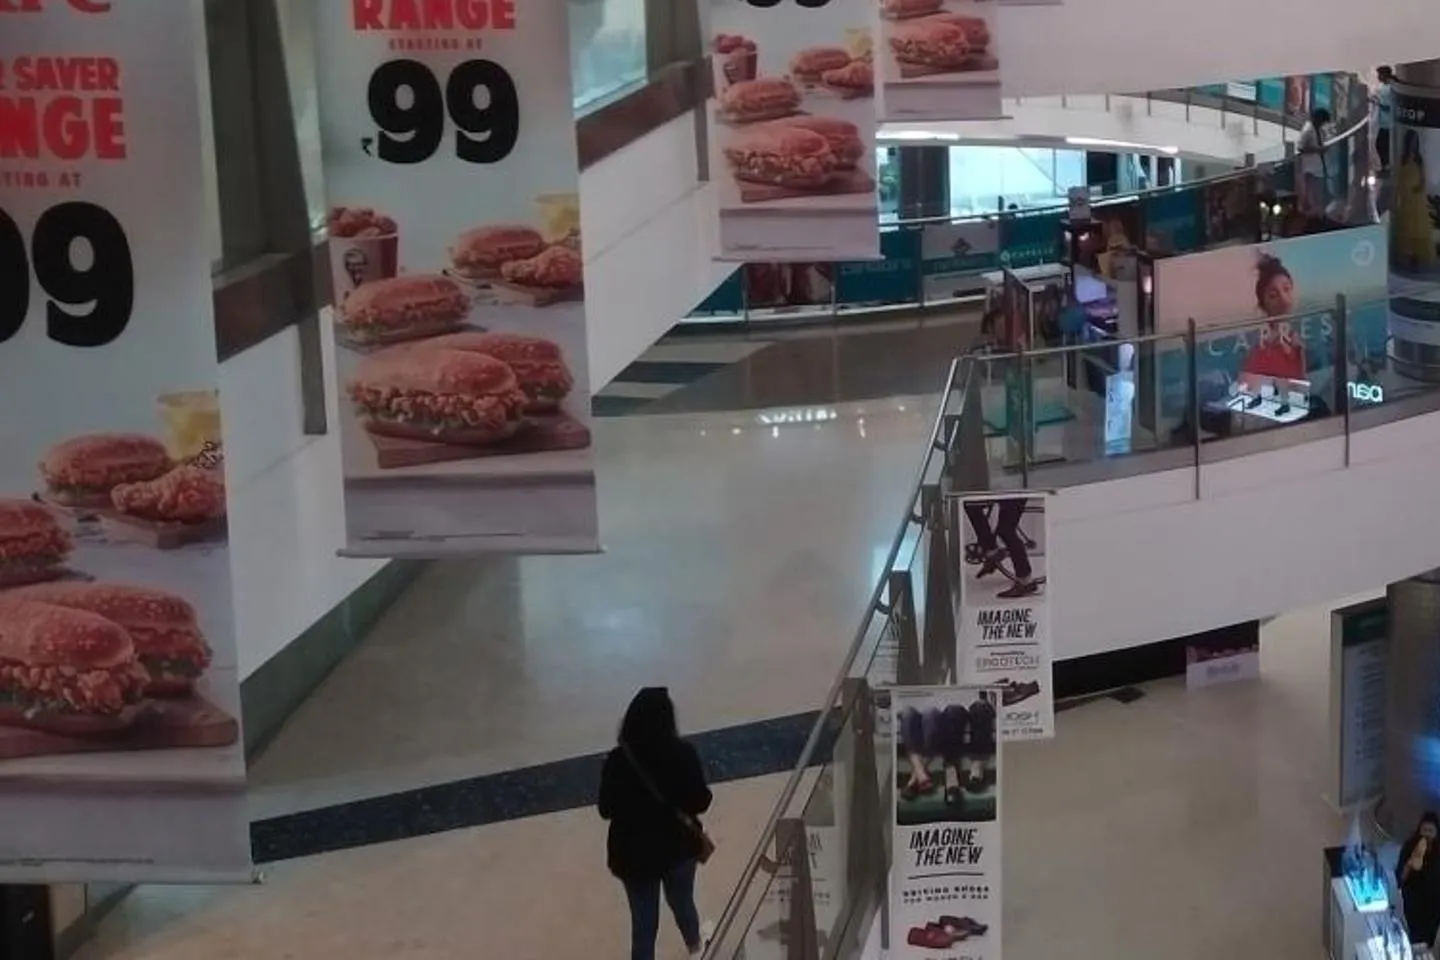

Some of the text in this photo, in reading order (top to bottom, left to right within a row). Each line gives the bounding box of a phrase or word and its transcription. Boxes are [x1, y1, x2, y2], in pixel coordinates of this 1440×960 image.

[12, 56, 120, 92] SAVER
[0, 96, 127, 160] NGE
[4, 171, 50, 188] TING
[1208, 312, 1334, 357] CAPRES
[976, 608, 1032, 626] IMAGINE
[982, 622, 1038, 640] THE NEW
[909, 828, 978, 849] IMAGINE
[915, 846, 983, 867] THE NEW
